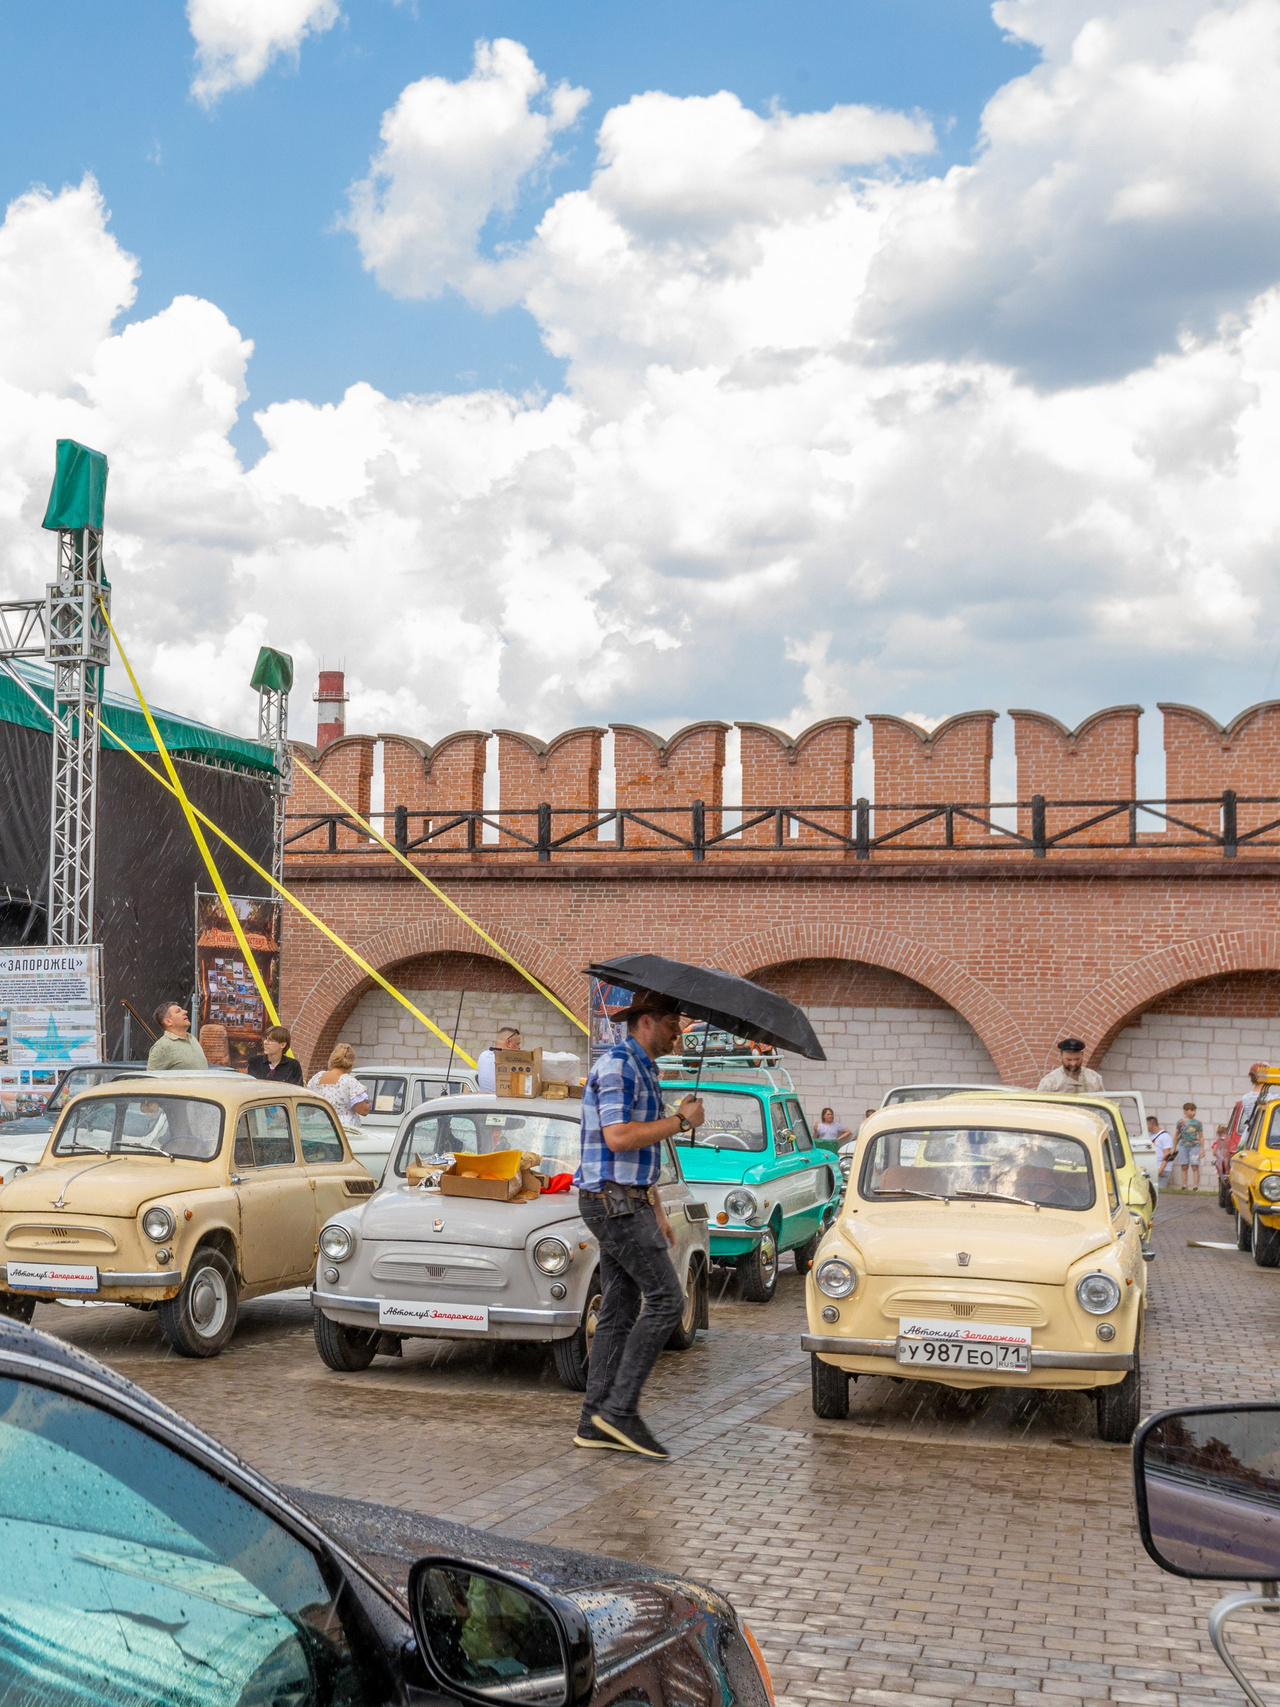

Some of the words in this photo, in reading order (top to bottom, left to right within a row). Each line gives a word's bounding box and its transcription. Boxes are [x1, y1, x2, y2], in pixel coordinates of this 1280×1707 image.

[0, 958, 83, 972] «ЗАПОРОЖЕЦ»
[10, 1268, 47, 1280] Автоклуб
[383, 1306, 429, 1319] Автоклуб
[903, 1325, 960, 1339] Автоклуб
[999, 1346, 1021, 1362] 71
